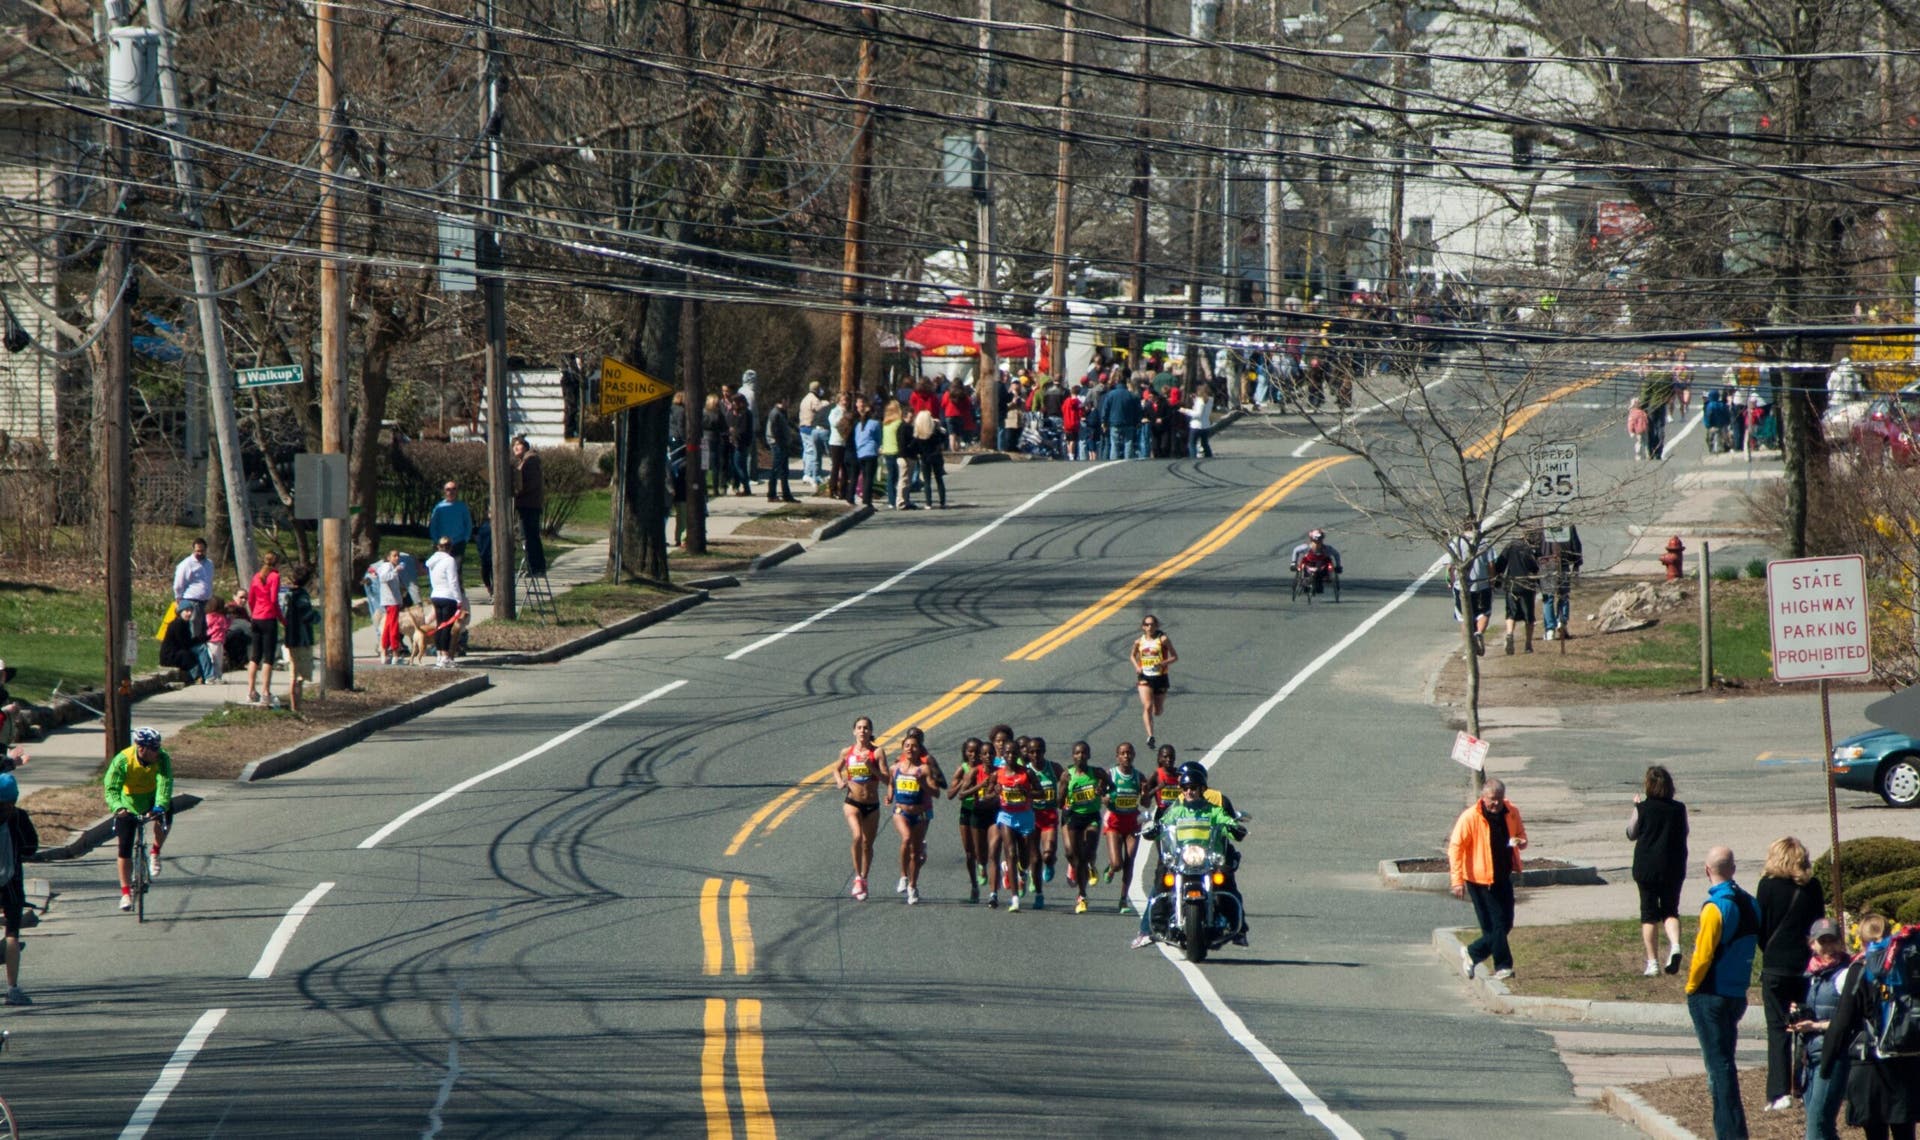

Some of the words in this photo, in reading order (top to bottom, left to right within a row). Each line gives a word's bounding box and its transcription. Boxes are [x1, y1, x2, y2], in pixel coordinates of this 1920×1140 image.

[247, 370, 293, 382] Walkup
[605, 369, 622, 379] NO
[605, 381, 656, 394] PASSING
[604, 394, 627, 405] ZONE
[1537, 475, 1573, 497] 35
[1792, 574, 1842, 590] STATE
[1781, 597, 1855, 614] HIGHWAY
[1783, 621, 1857, 639] PARKING
[1778, 645, 1866, 664] PROHIBITED
